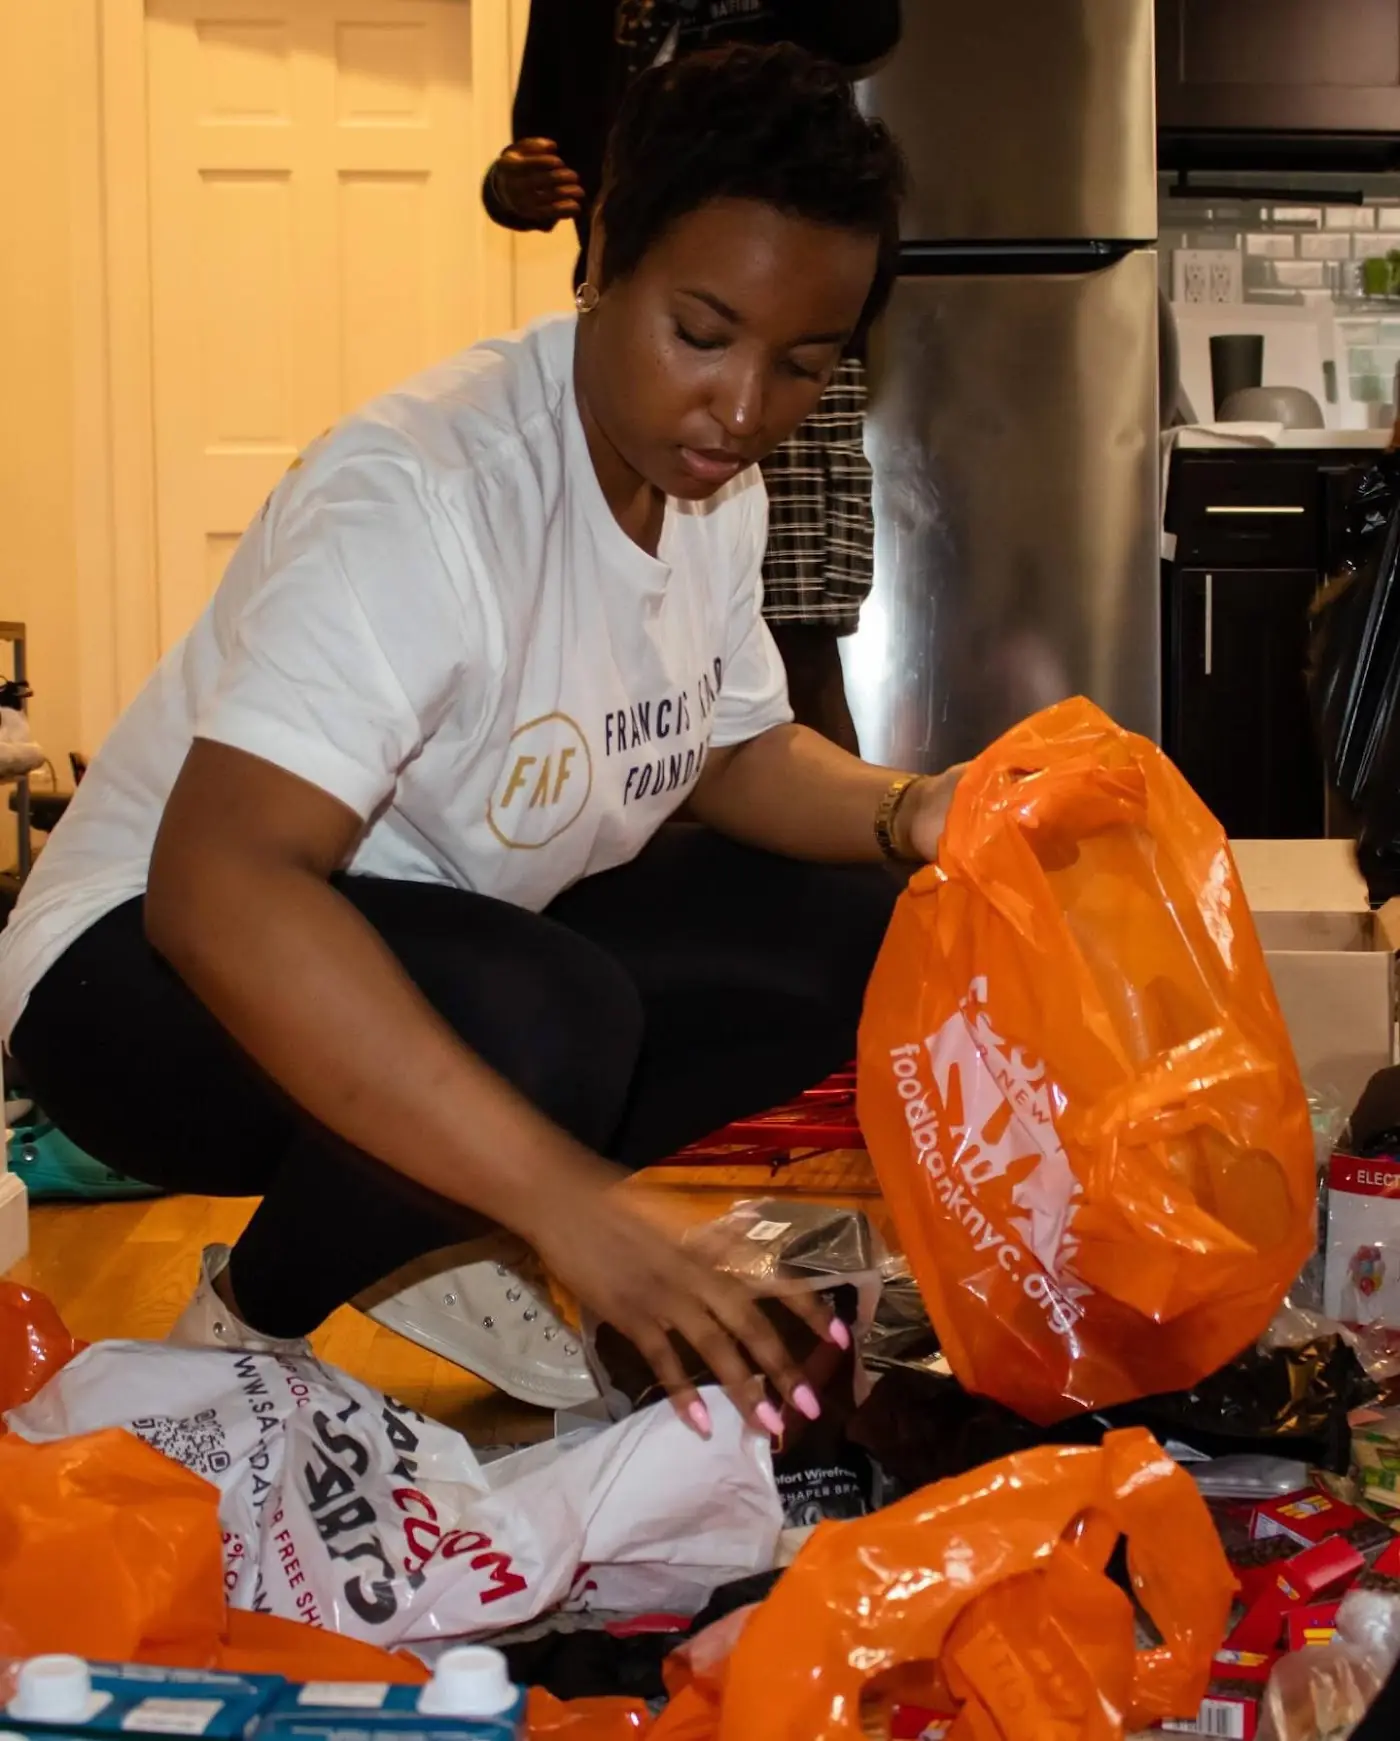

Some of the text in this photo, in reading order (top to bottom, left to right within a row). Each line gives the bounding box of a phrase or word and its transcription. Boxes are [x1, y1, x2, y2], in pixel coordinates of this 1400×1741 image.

[996, 1068, 1051, 1125] NEW
[889, 1042, 1080, 1334] foodbanknyc.org
[274, 1529, 305, 1590] FREE
